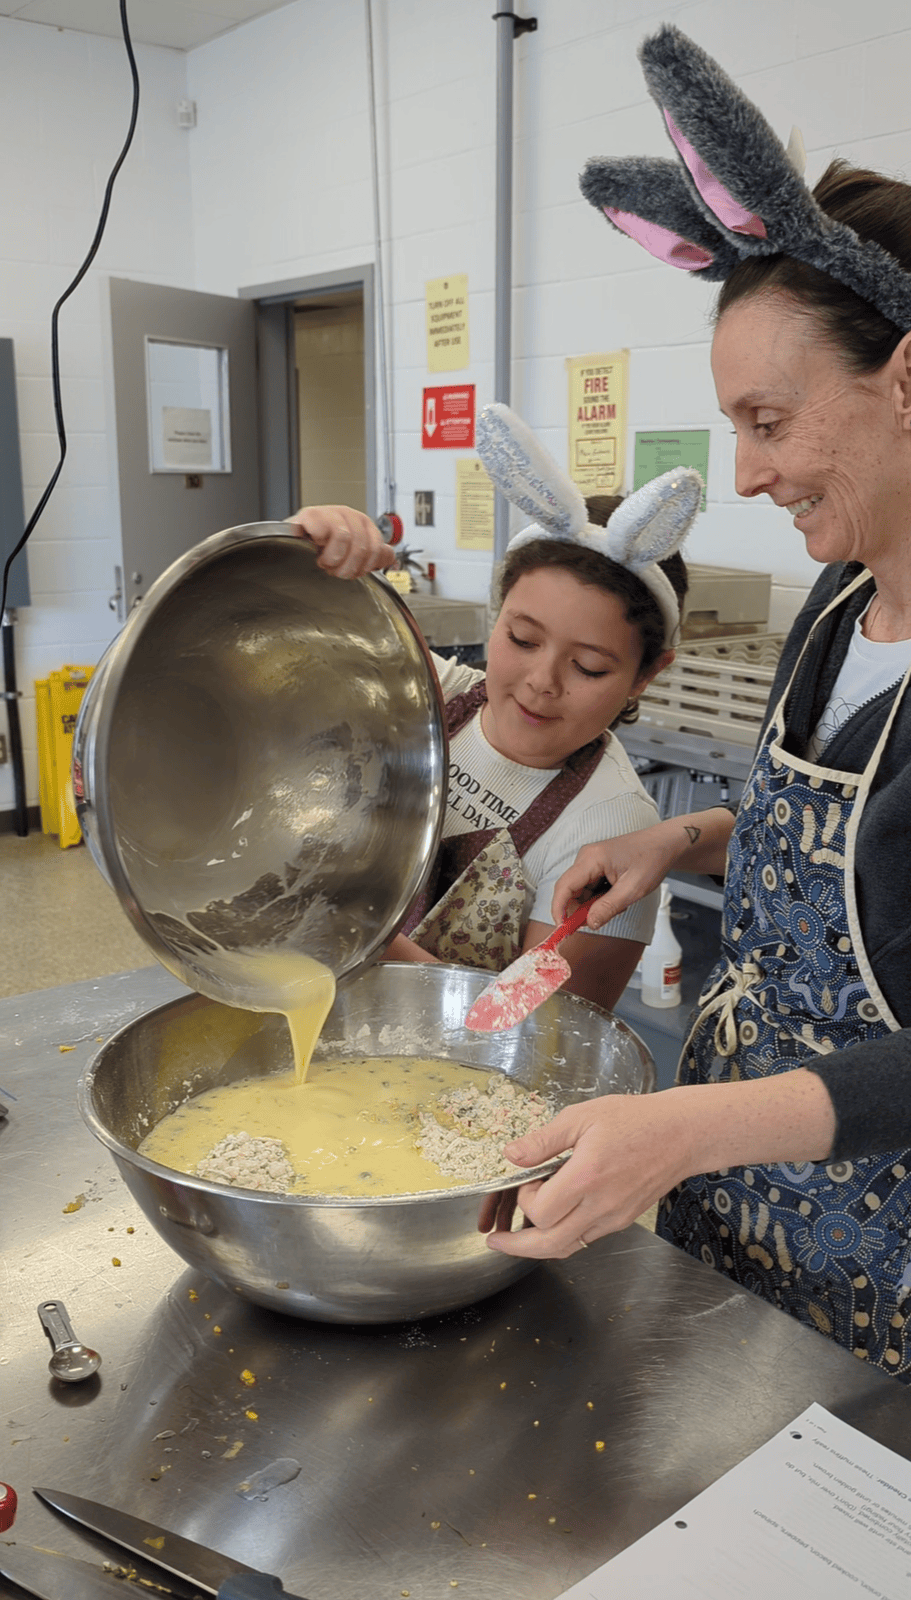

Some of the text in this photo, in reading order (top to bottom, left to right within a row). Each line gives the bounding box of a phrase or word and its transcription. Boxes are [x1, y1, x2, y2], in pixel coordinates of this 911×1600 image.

[584, 377, 608, 393] FIRE
[577, 404, 617, 421] ALARM
[449, 764, 520, 825] OOD TIME
[462, 805, 495, 830] DAY
[785, 1461, 795, 1469] do
[794, 1468, 807, 1478] but
